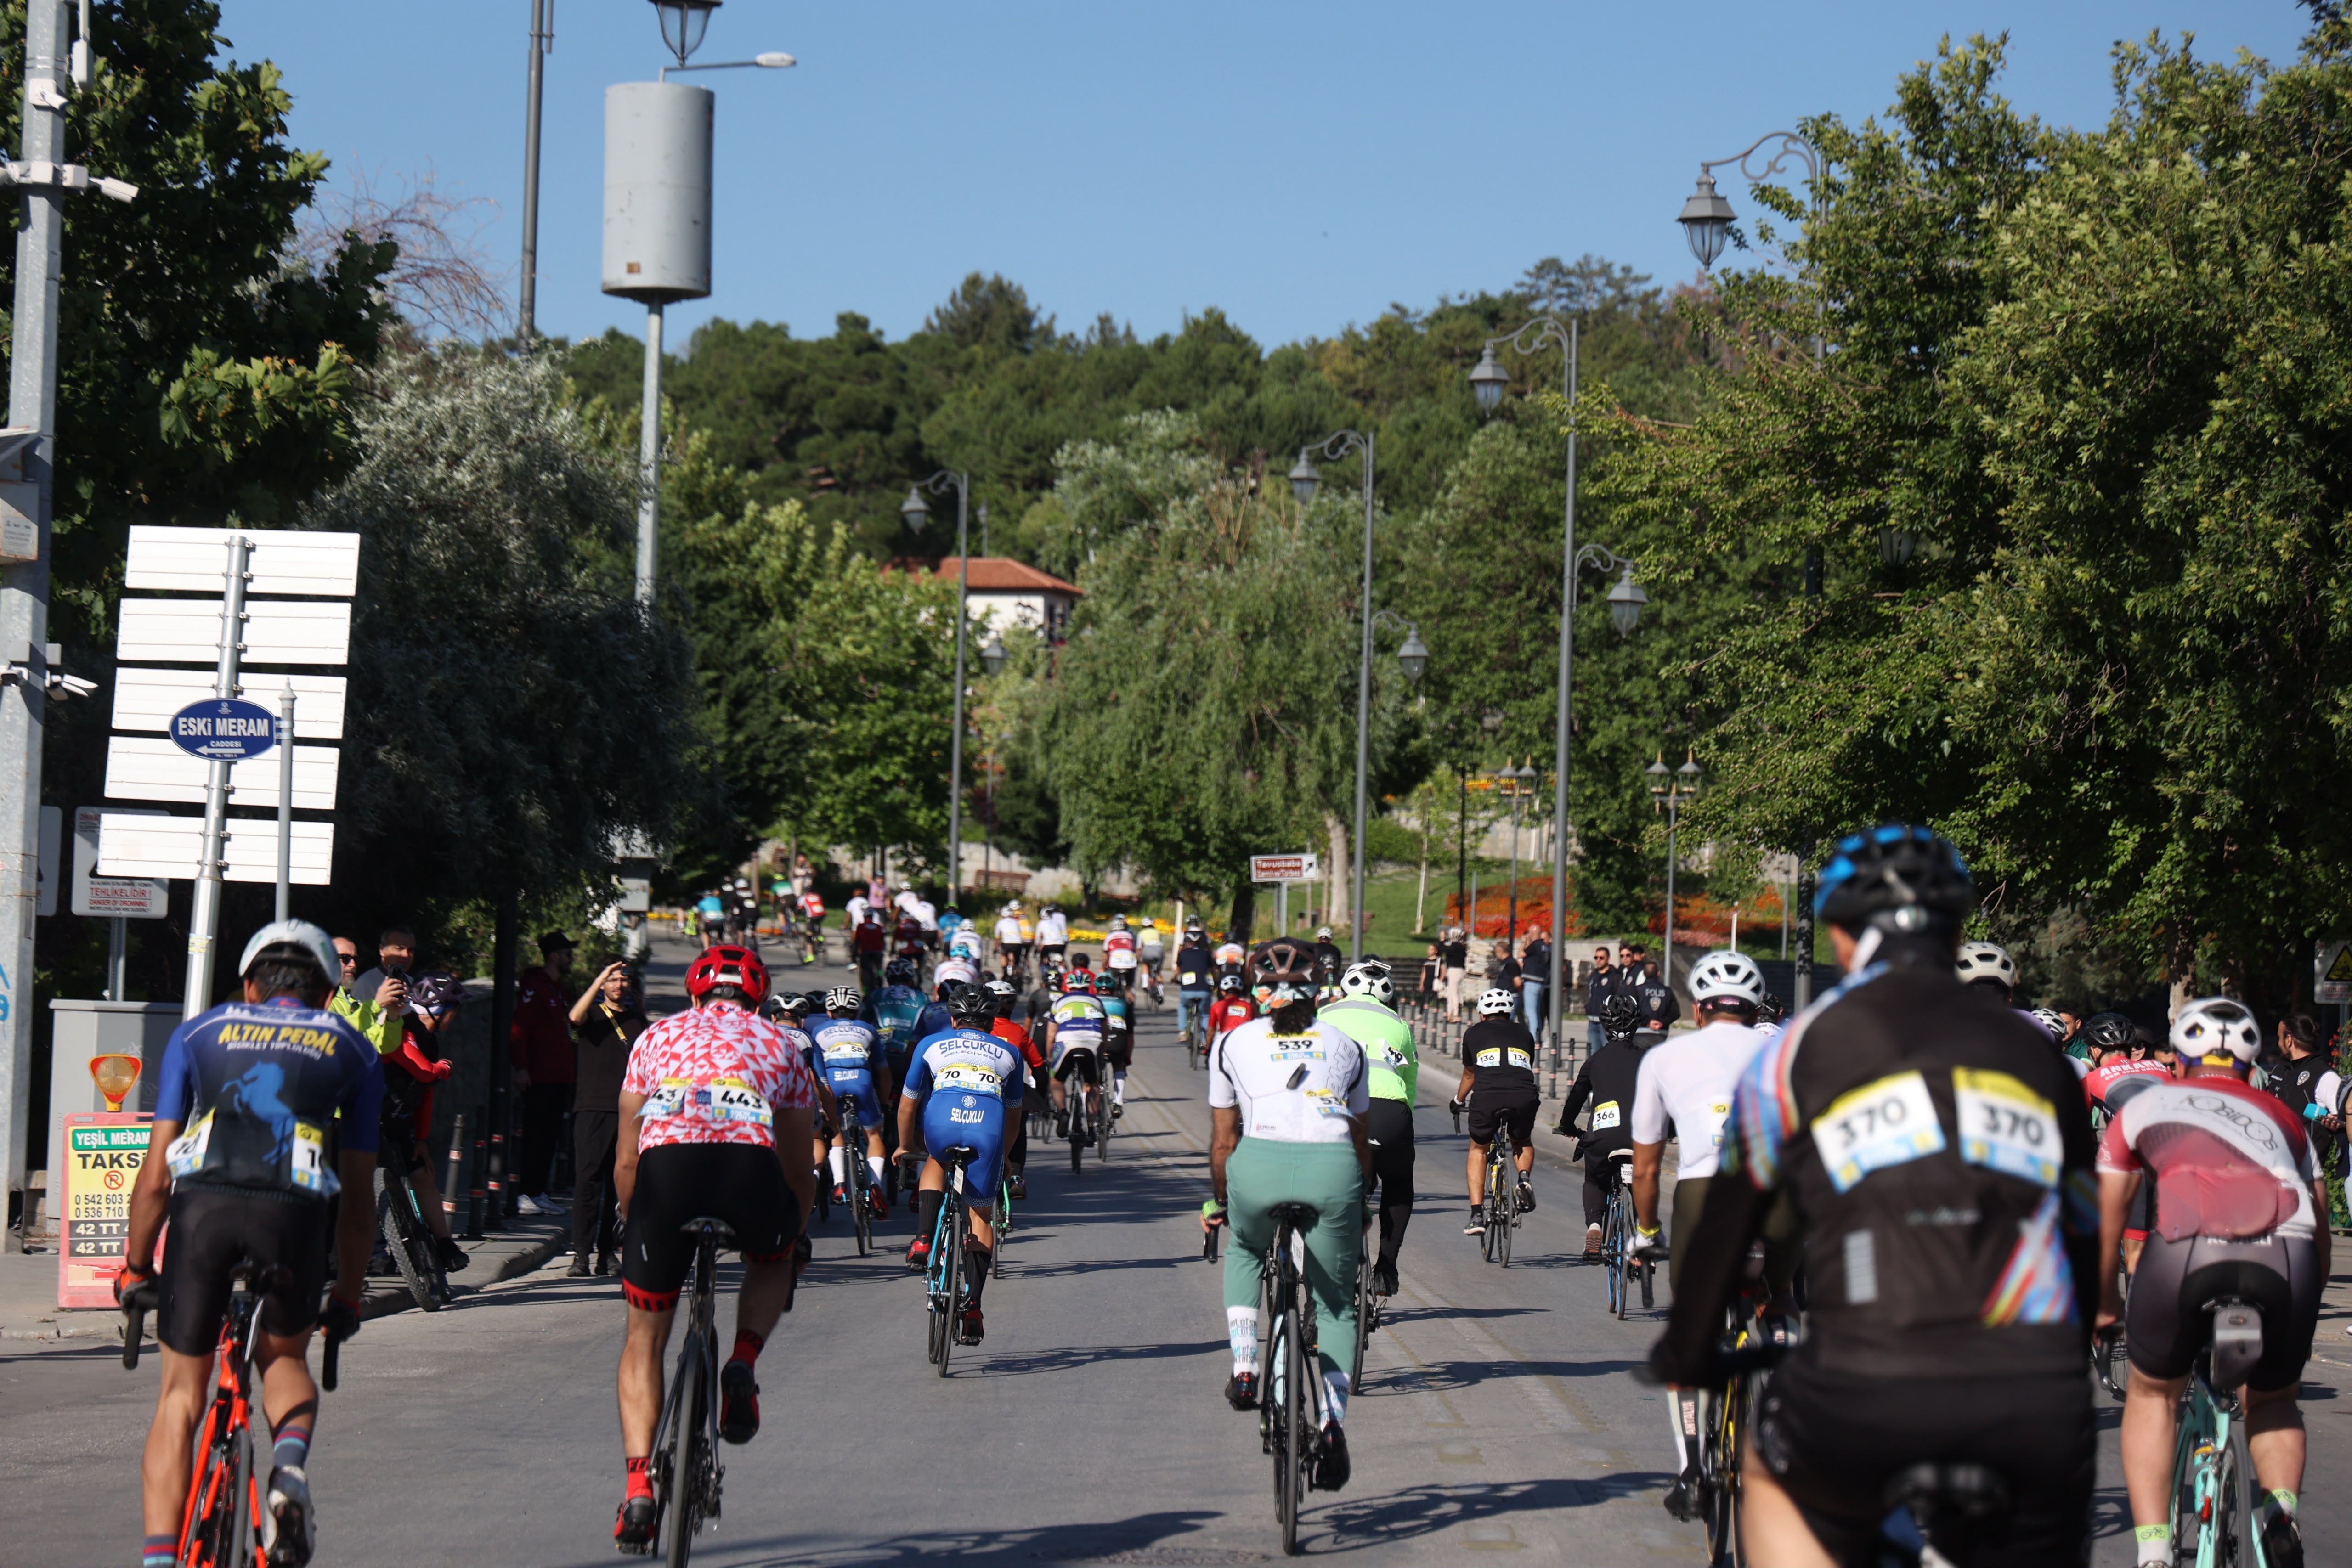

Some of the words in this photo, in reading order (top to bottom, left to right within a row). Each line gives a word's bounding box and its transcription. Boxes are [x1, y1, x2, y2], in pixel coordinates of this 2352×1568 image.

[215, 718, 269, 736] MERAM
[90, 887, 147, 897] TEHLİKELİDİR
[218, 1024, 276, 1045] ALTIN
[277, 1026, 338, 1056] PEDAL
[1278, 1040, 1313, 1050] 539
[939, 1040, 1003, 1059] SELÇUKLU
[944, 1050, 996, 1062] BELEDİYESİ
[1480, 1055, 1494, 1064] 136
[2100, 1060, 2166, 1077] ANKARA
[944, 1071, 960, 1079] 70
[979, 1073, 995, 1083] 70
[721, 1090, 762, 1109] 443
[950, 1107, 984, 1125] SELÇUKLU
[1596, 1110, 1615, 1122] 366
[1837, 1097, 1907, 1148] 370
[1980, 1102, 2044, 1146] 370
[76, 1130, 108, 1148] YEŞİL
[111, 1131, 151, 1145] MERAM
[307, 1148, 322, 1169] 1
[75, 1195, 81, 1205] 0
[84, 1195, 102, 1205] 542
[106, 1194, 123, 1205] 603
[75, 1208, 81, 1218] 0
[84, 1207, 102, 1218] 536
[106, 1207, 123, 1217] 710
[76, 1223, 96, 1235] 42
[99, 1223, 121, 1235] TT
[76, 1242, 96, 1254] 42
[99, 1242, 121, 1254] TT
[1240, 1318, 1248, 1326] of
